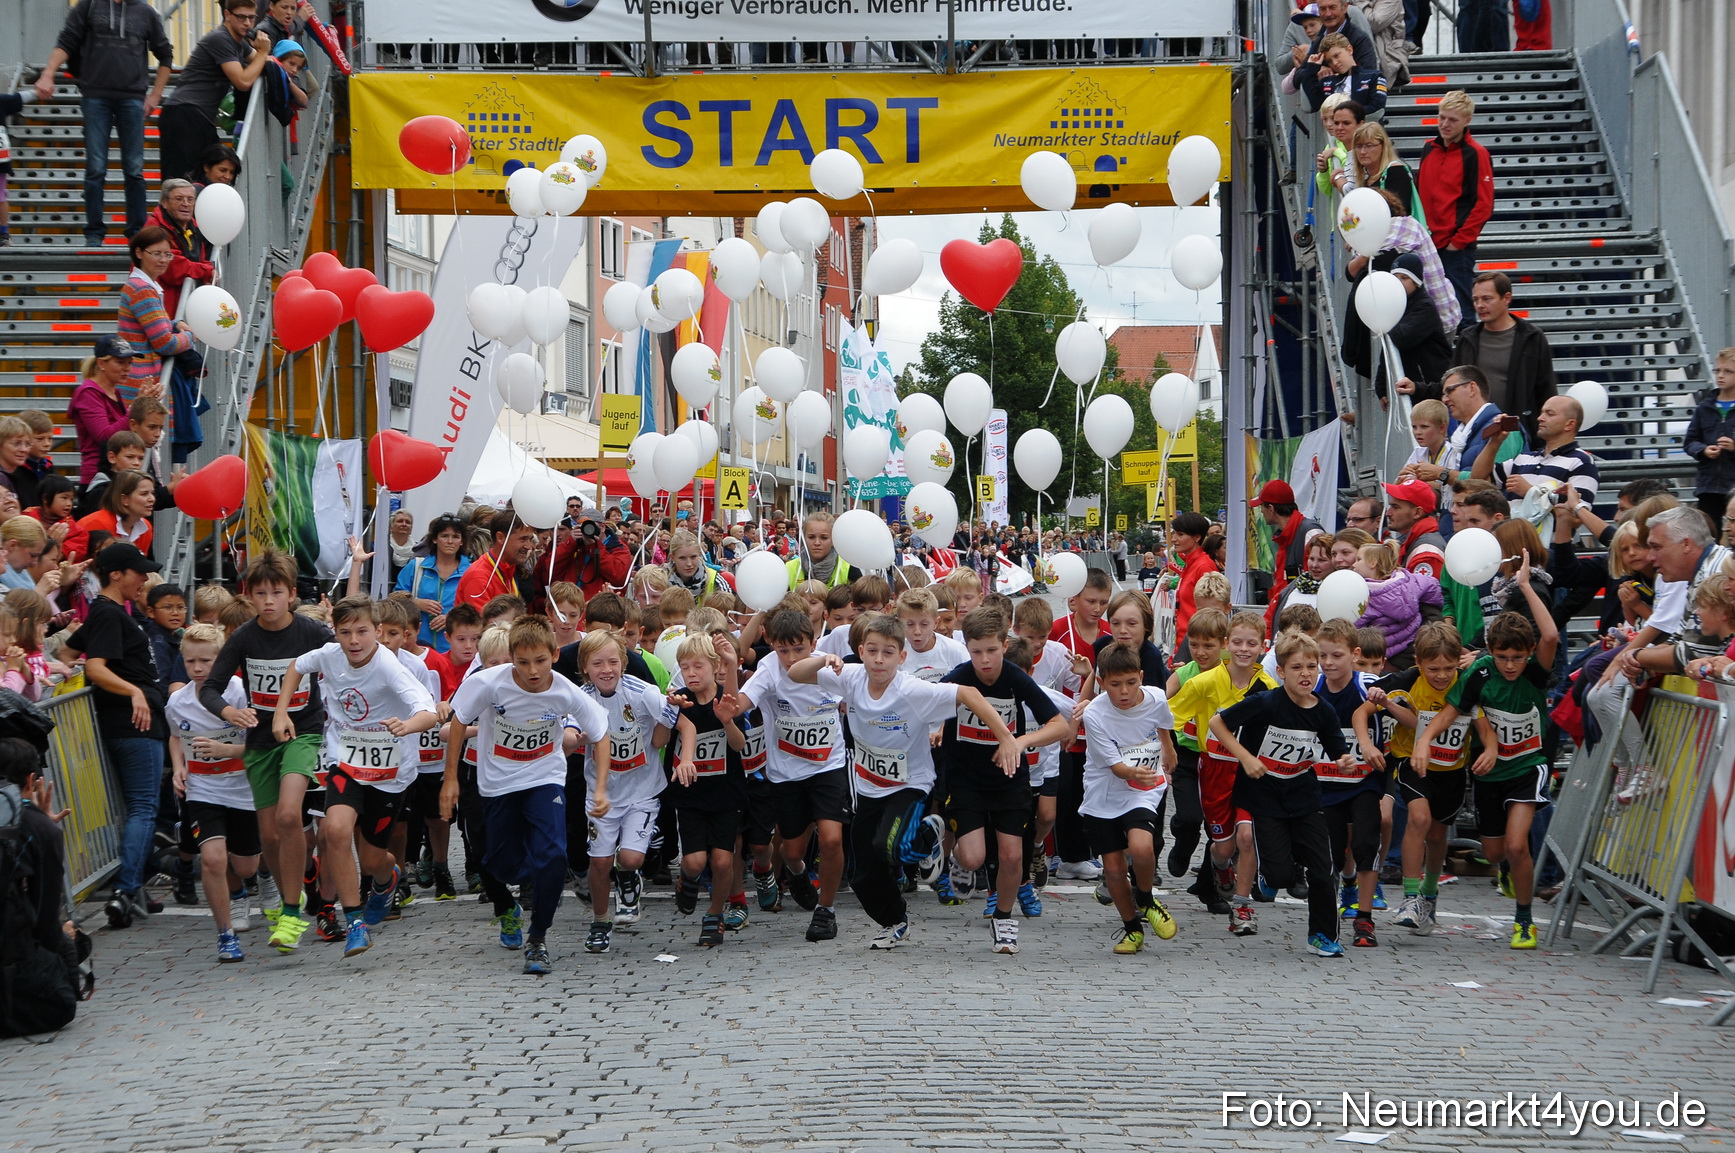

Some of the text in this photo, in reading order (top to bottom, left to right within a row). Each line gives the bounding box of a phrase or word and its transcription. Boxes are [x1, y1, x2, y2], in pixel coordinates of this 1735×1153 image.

[867, 0, 926, 13] Mehr
[641, 96, 939, 168] START
[993, 130, 1182, 148] Neumarkter Stadtlauf
[602, 408, 639, 421] Jugend-
[611, 420, 629, 430] lauf
[724, 468, 746, 477] Block
[1138, 468, 1151, 476] lauf
[725, 480, 742, 500] A
[981, 484, 991, 496] B
[1089, 512, 1096, 522] C
[1119, 519, 1125, 527] D
[247, 663, 267, 671] PARTL
[495, 720, 549, 733] PARTL Neumarkt
[776, 719, 798, 727] PARTL
[340, 734, 359, 743] PARTL
[501, 730, 550, 750] 7268
[782, 726, 830, 747] 7062
[1267, 730, 1289, 741] PARTL
[346, 745, 394, 767] 7187
[511, 751, 538, 760] Jonas
[858, 747, 900, 779] 7064
